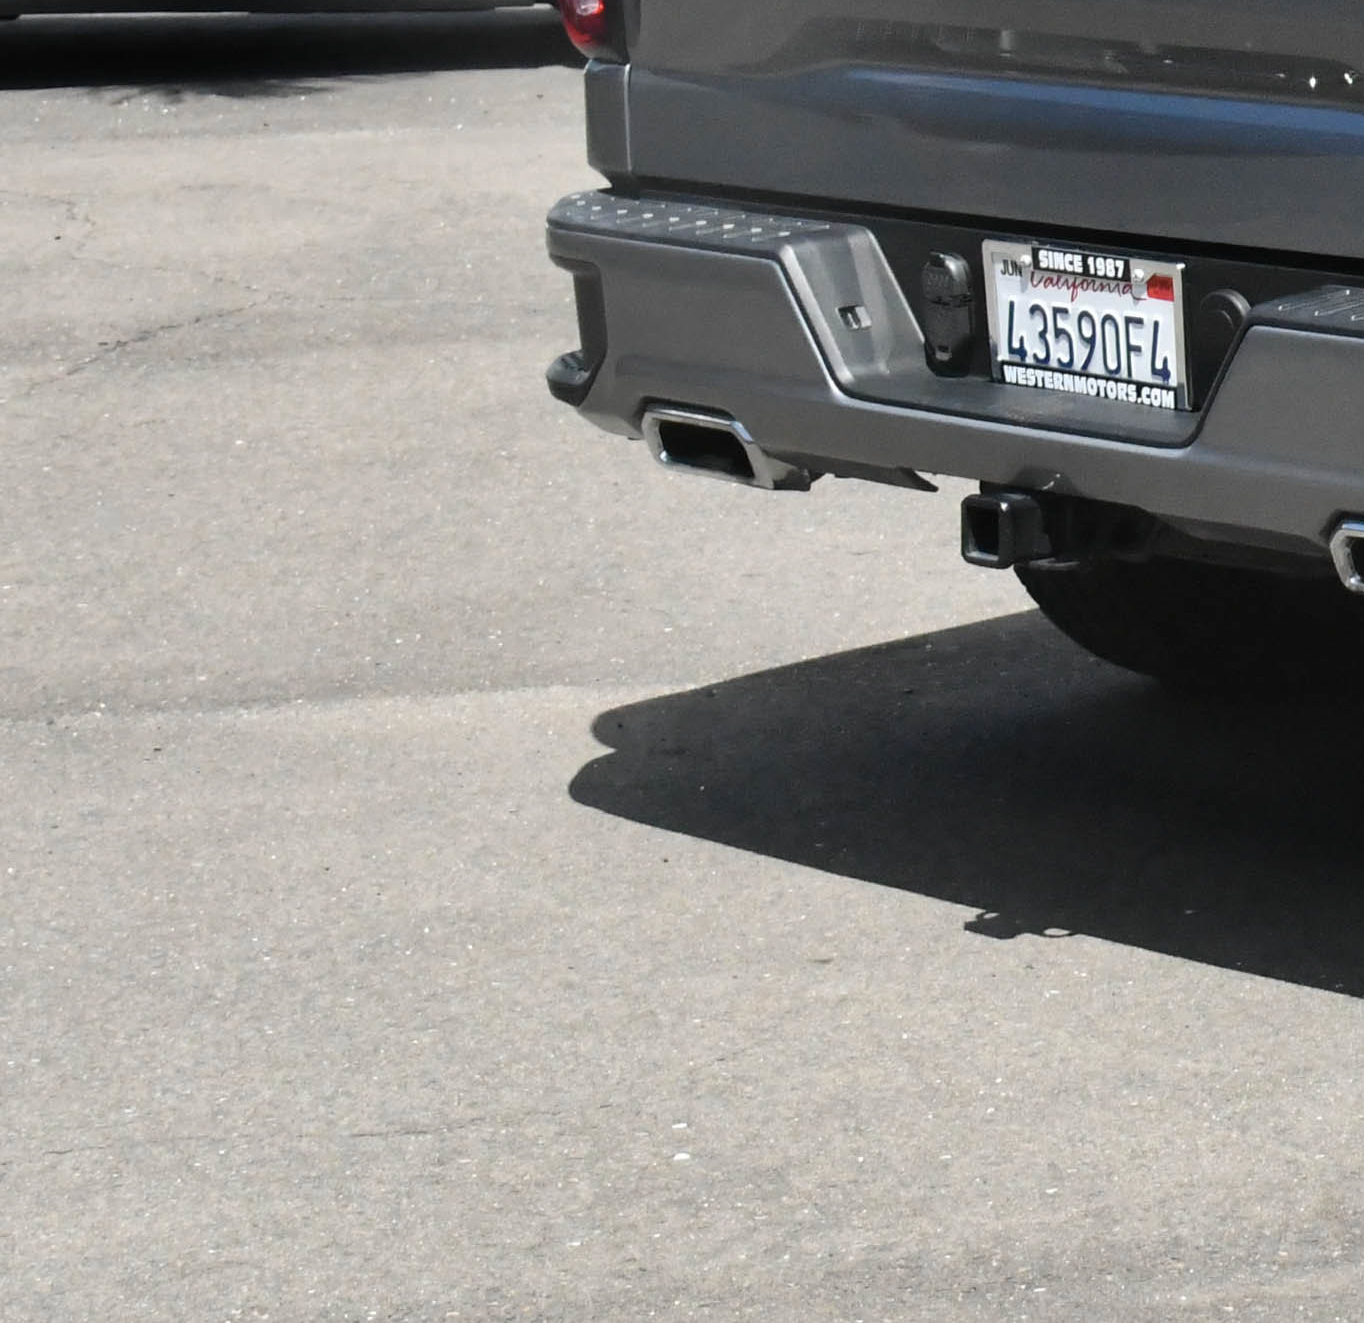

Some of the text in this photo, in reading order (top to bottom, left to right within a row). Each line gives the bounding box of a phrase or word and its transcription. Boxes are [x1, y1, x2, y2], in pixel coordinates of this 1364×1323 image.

[1000, 259, 1023, 278] JUN
[1038, 250, 1125, 278] SINCE 1987
[1030, 271, 1147, 302] California
[1007, 300, 1172, 385] 43590F4
[1003, 365, 1176, 410] WESTERNMOTORS.COM
